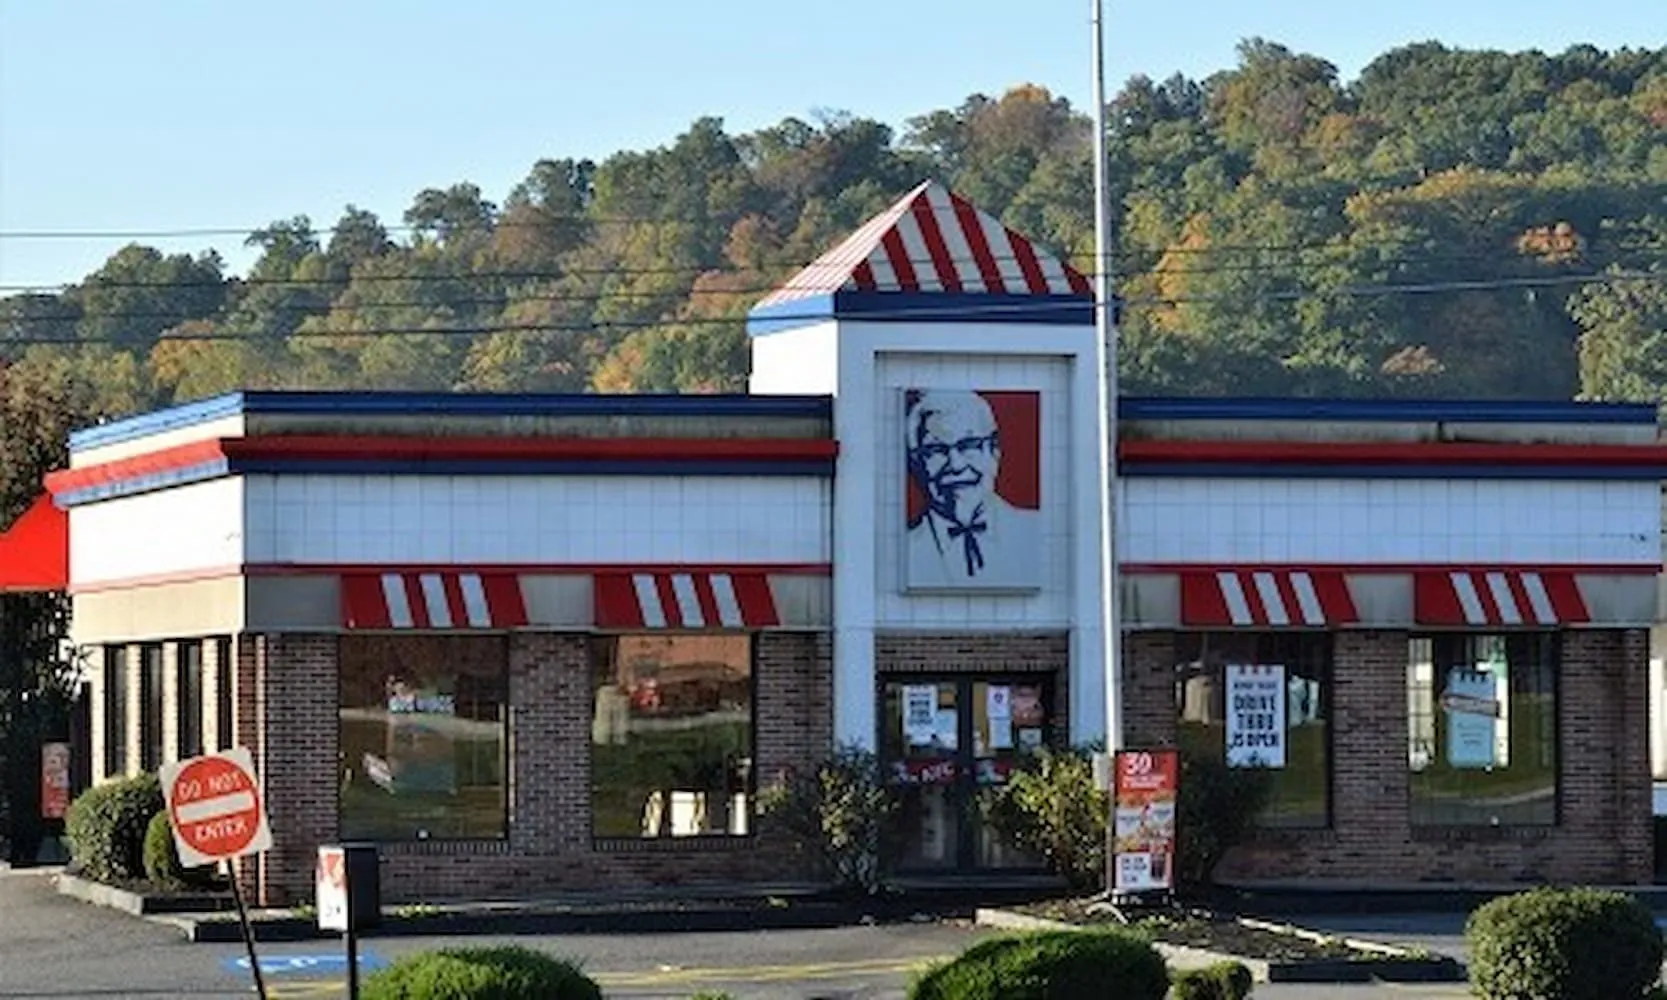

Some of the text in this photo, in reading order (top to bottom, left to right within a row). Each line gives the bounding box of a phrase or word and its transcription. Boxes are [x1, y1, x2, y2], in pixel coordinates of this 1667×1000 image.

[178, 771, 242, 801] DO NOT
[194, 817, 248, 842] ENTER
